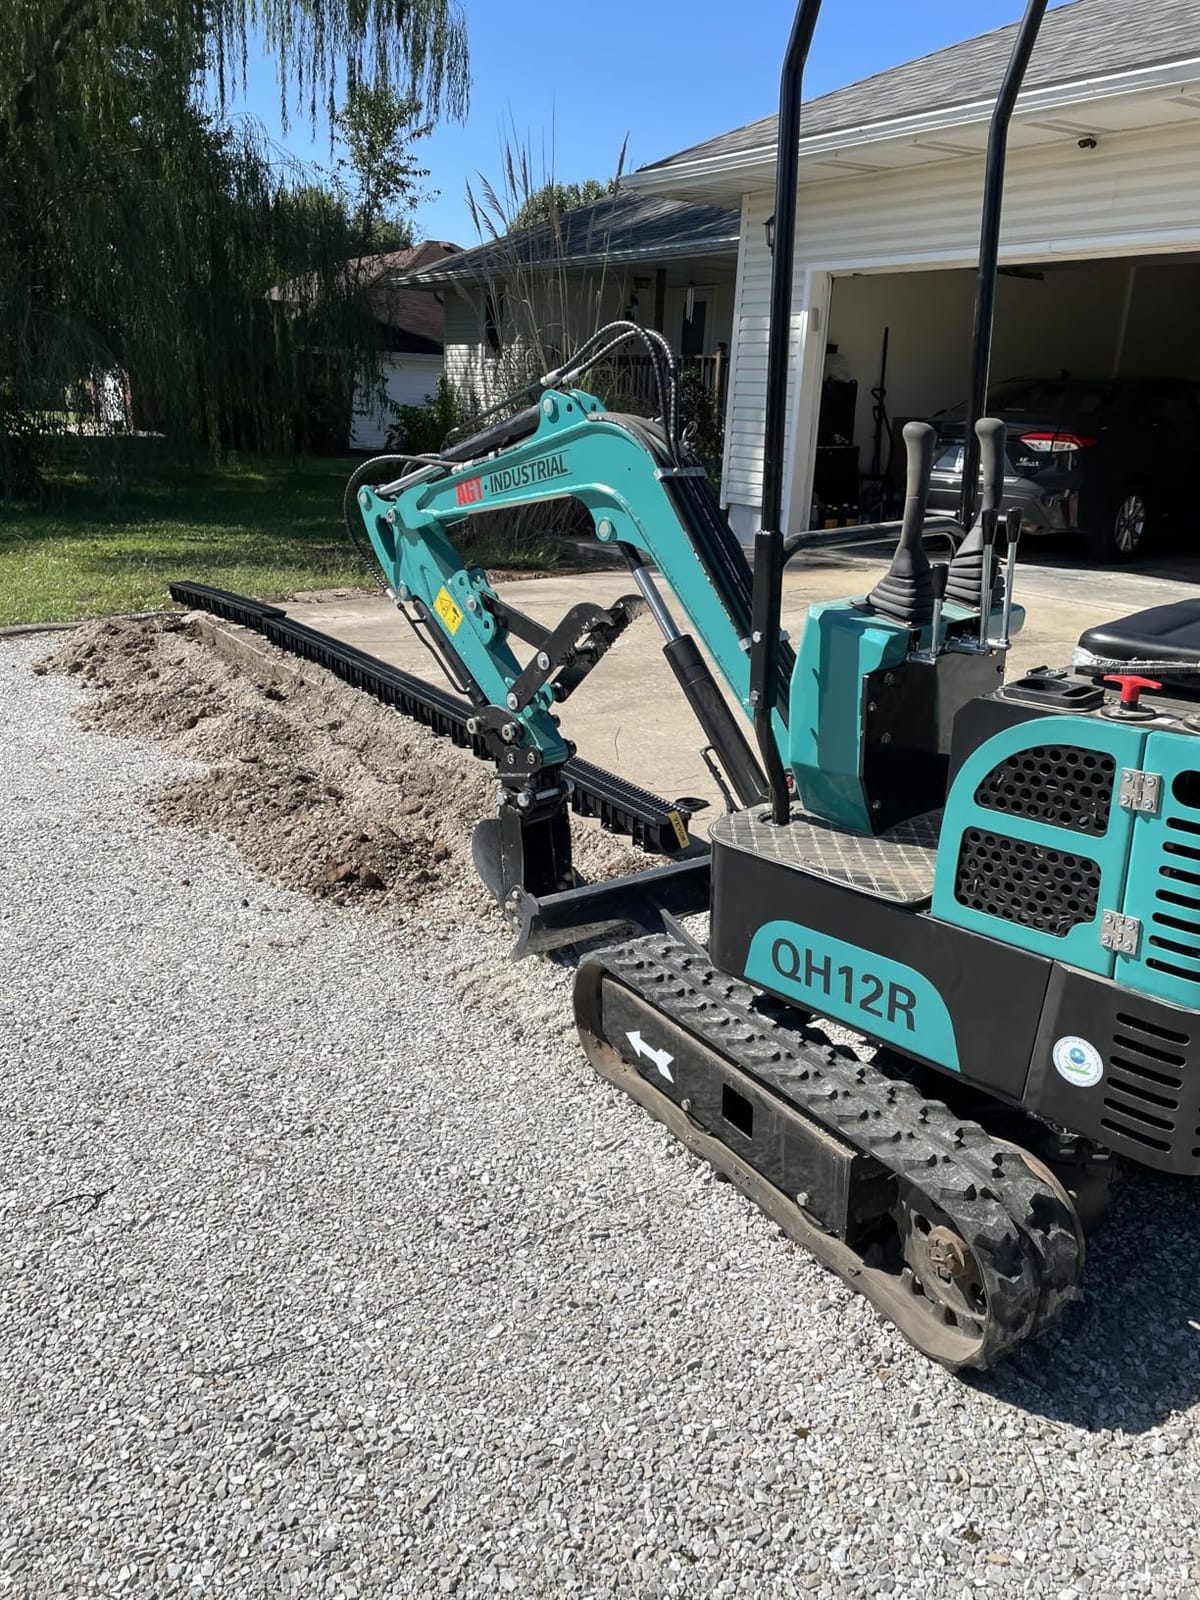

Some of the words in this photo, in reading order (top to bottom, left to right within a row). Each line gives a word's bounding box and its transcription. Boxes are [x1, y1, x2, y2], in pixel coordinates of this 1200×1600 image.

[456, 475, 483, 505] AGT
[489, 454, 568, 493] INDUSTRIAL
[771, 937, 917, 1032] QH12R
